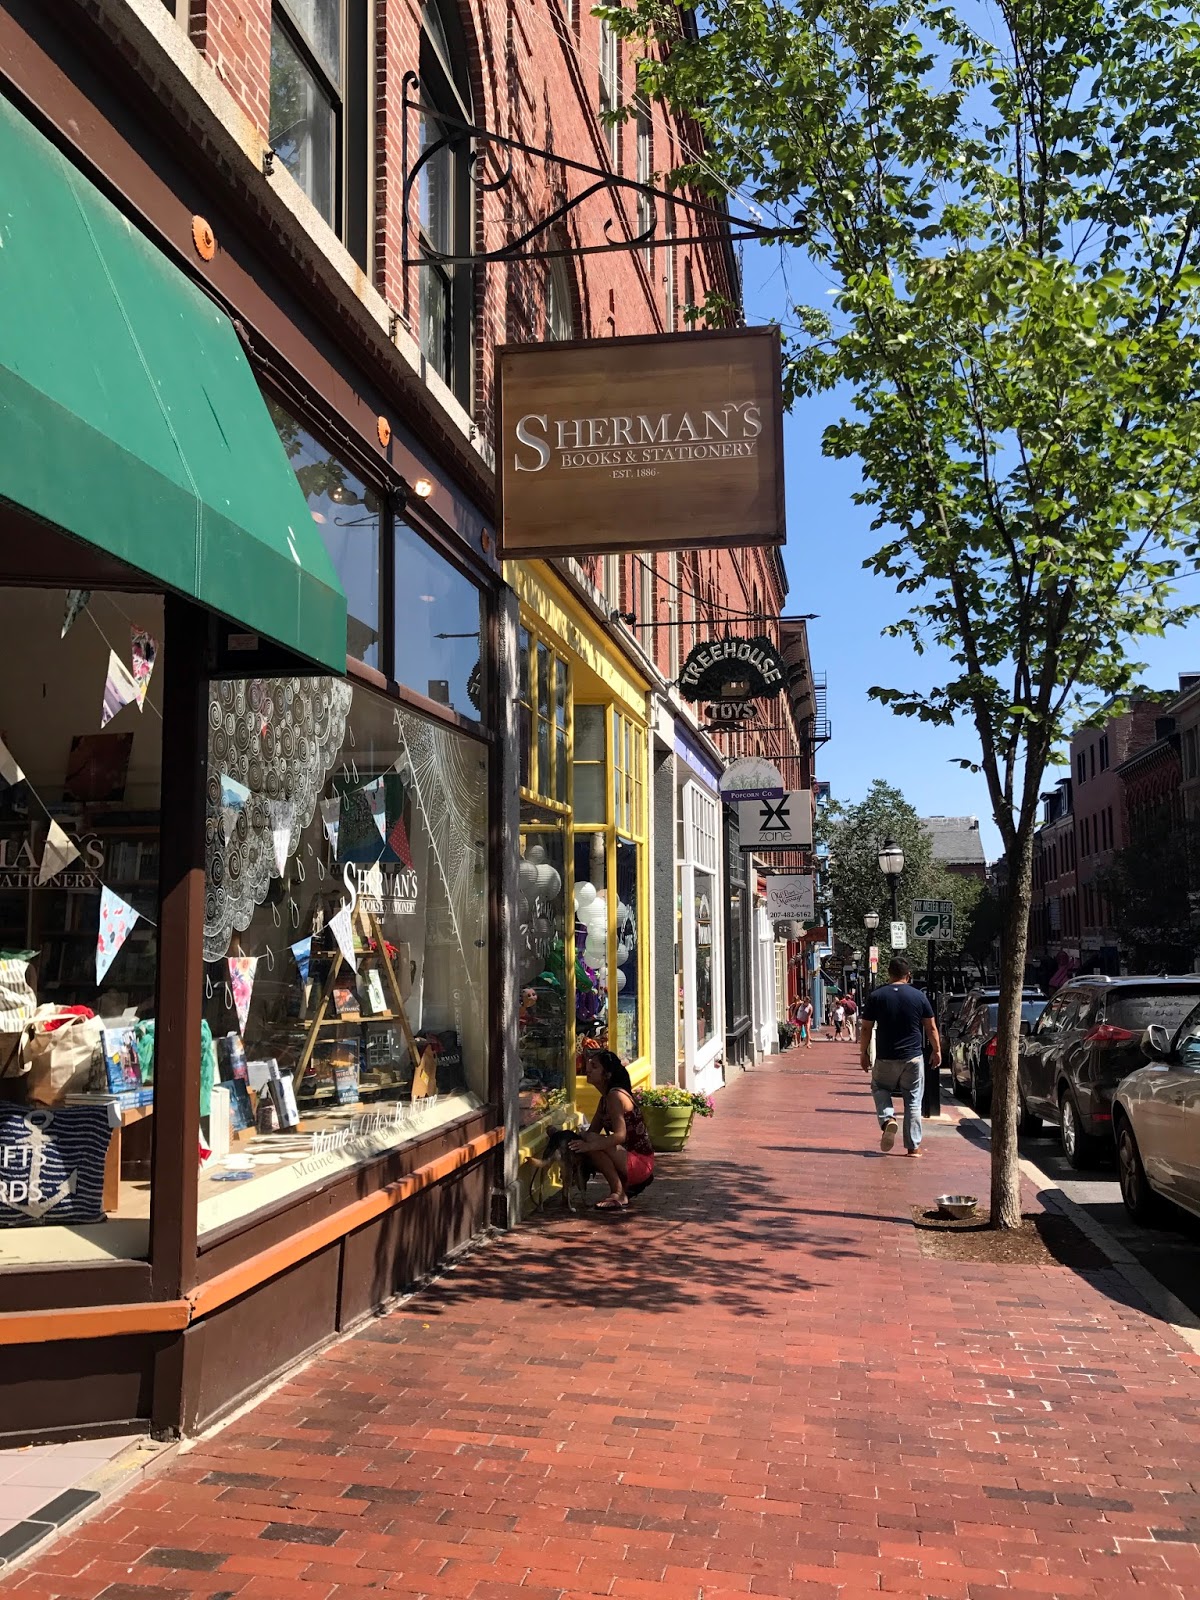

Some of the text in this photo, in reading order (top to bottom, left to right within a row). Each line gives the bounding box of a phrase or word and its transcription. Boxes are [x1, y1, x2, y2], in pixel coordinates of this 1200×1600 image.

[514, 401, 763, 472] SHERMAN'S
[562, 442, 757, 467] BOOKS & STATIONERY
[681, 642, 782, 685] TREEHOUSE
[709, 703, 753, 719] TOYS
[759, 832, 792, 842] zane
[0, 874, 99, 888] ATIONERY
[914, 901, 953, 913] PAY METER HERE
[942, 914, 950, 923] 2
[0, 1145, 47, 1168] FTS
